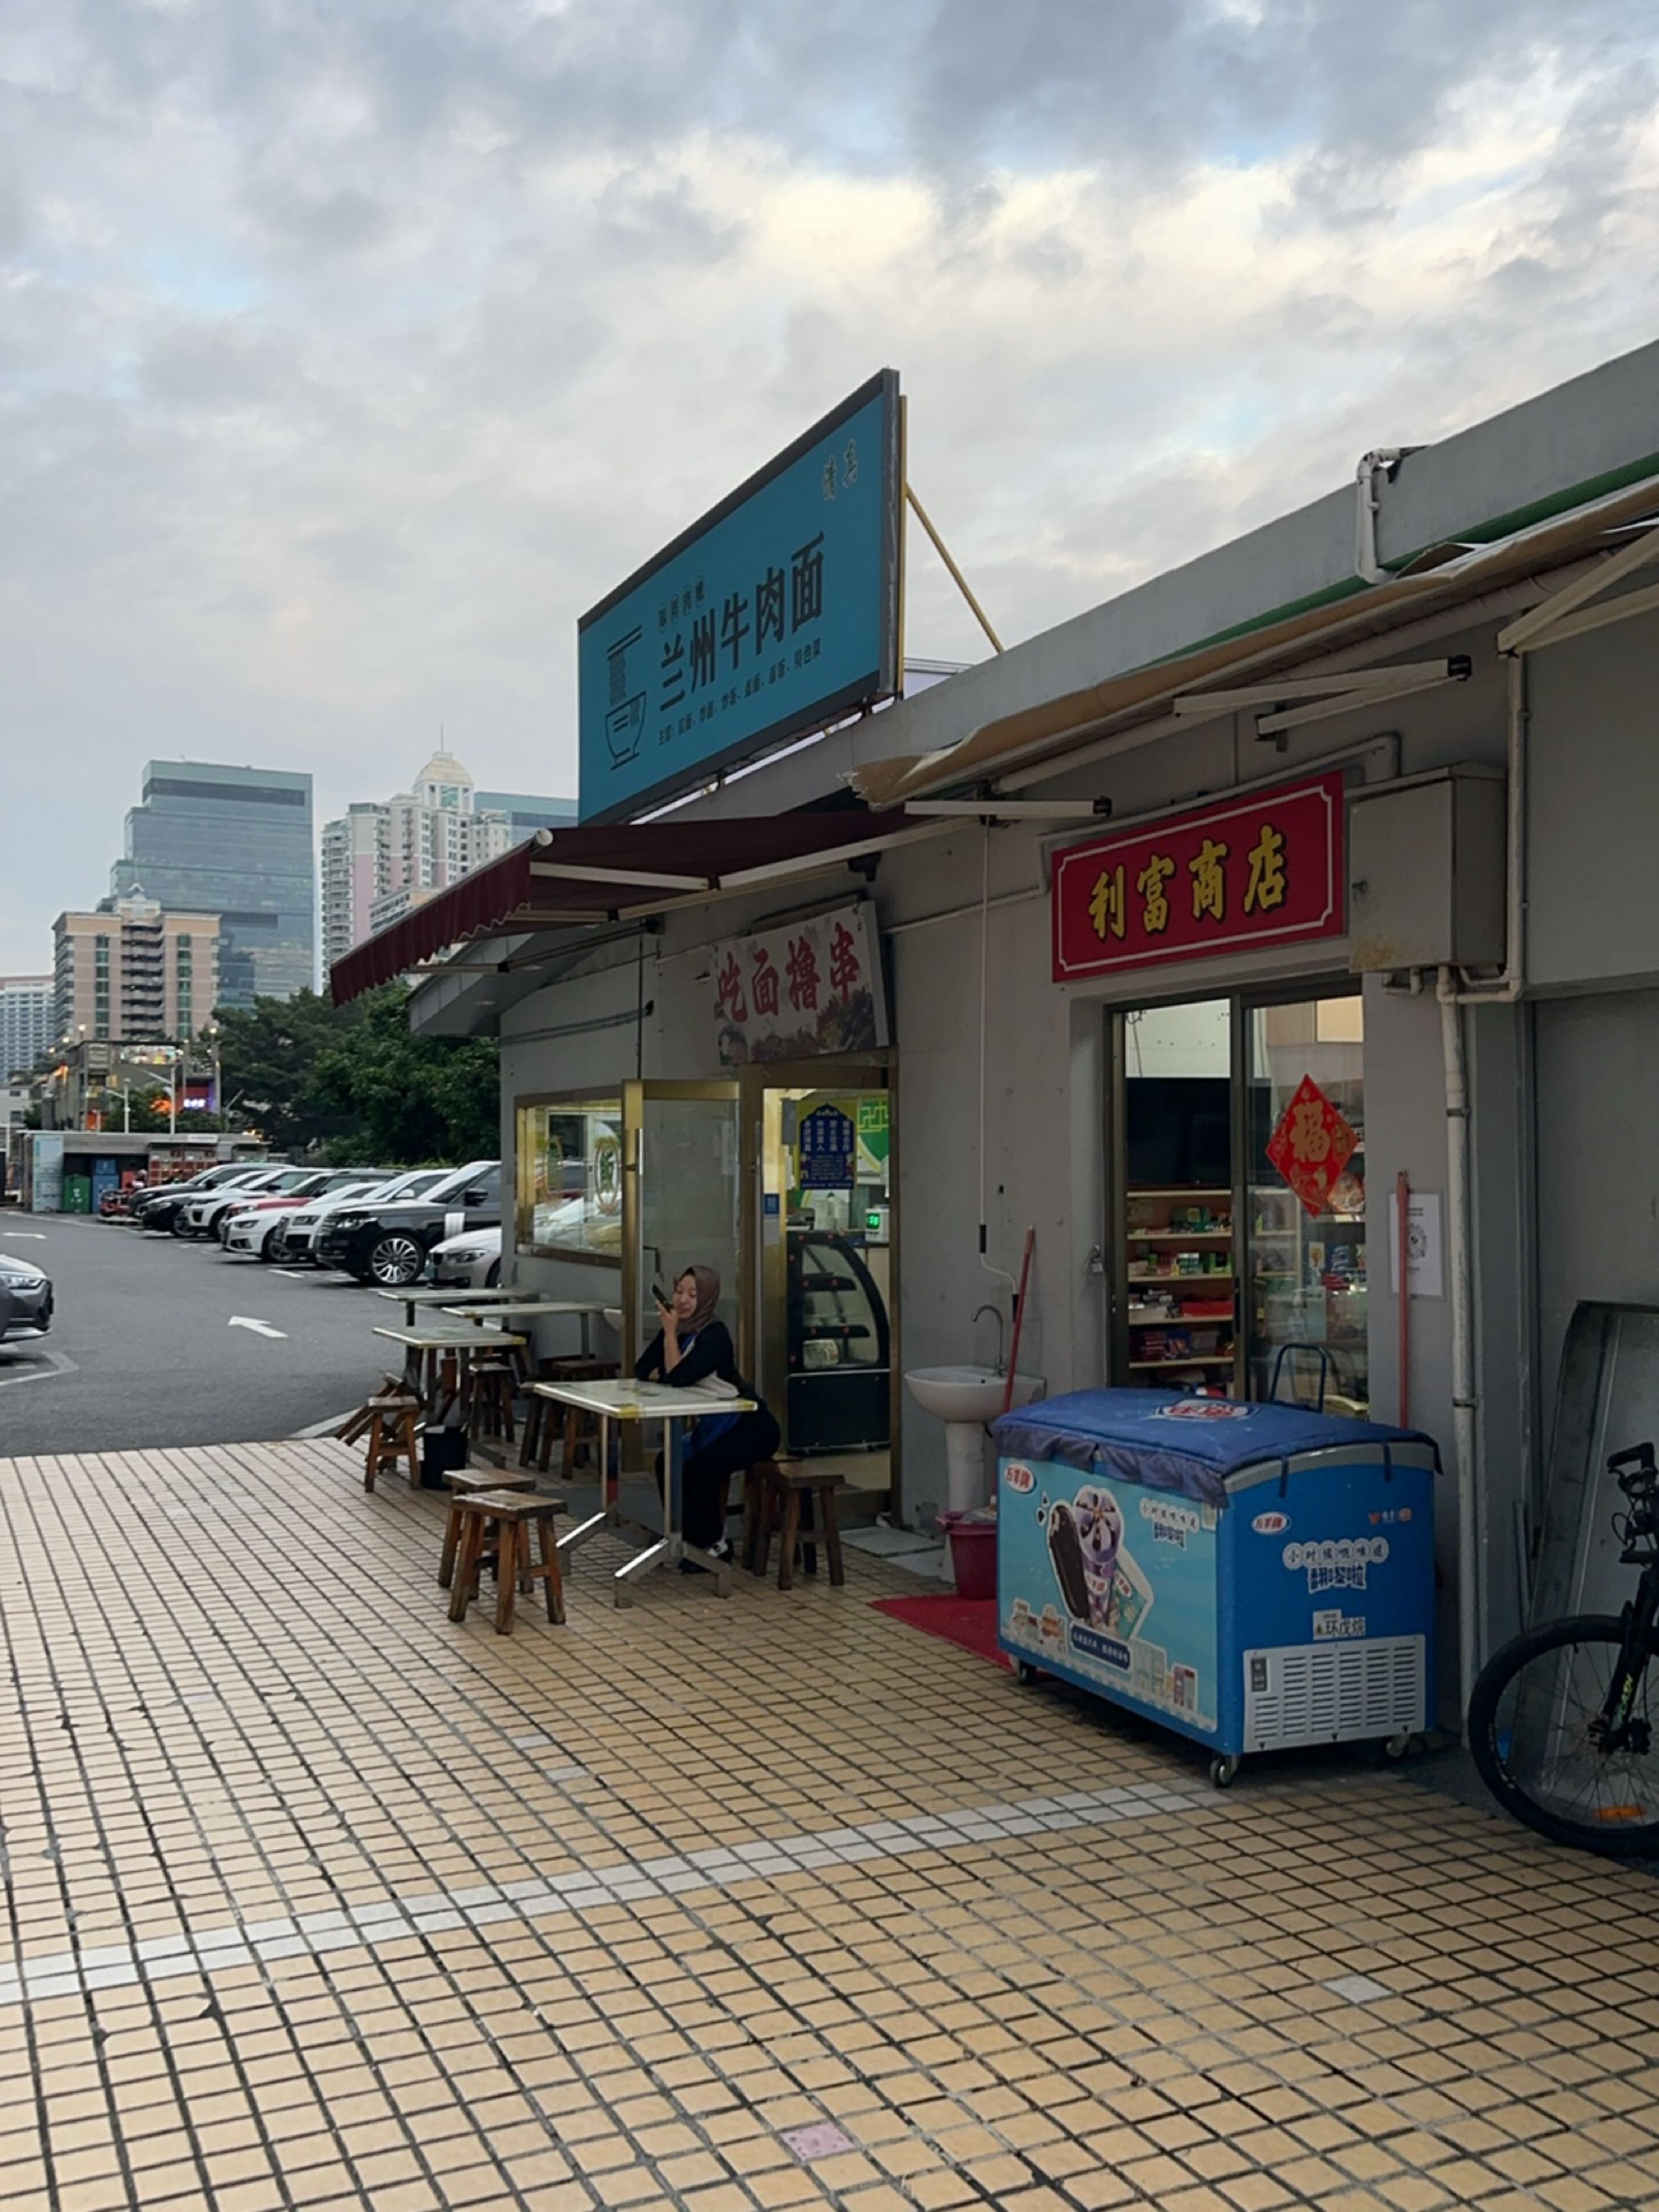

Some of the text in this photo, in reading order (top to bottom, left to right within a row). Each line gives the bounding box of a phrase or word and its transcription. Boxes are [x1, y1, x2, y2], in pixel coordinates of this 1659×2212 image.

[823, 438, 858, 501] 清真
[660, 531, 824, 711] 兰州牛肉面
[1088, 824, 1286, 940] 利富商店
[1290, 1099, 1331, 1164] 福
[1006, 1467, 1030, 1488] 五羊牌
[1255, 1516, 1285, 1530] 五羊牌
